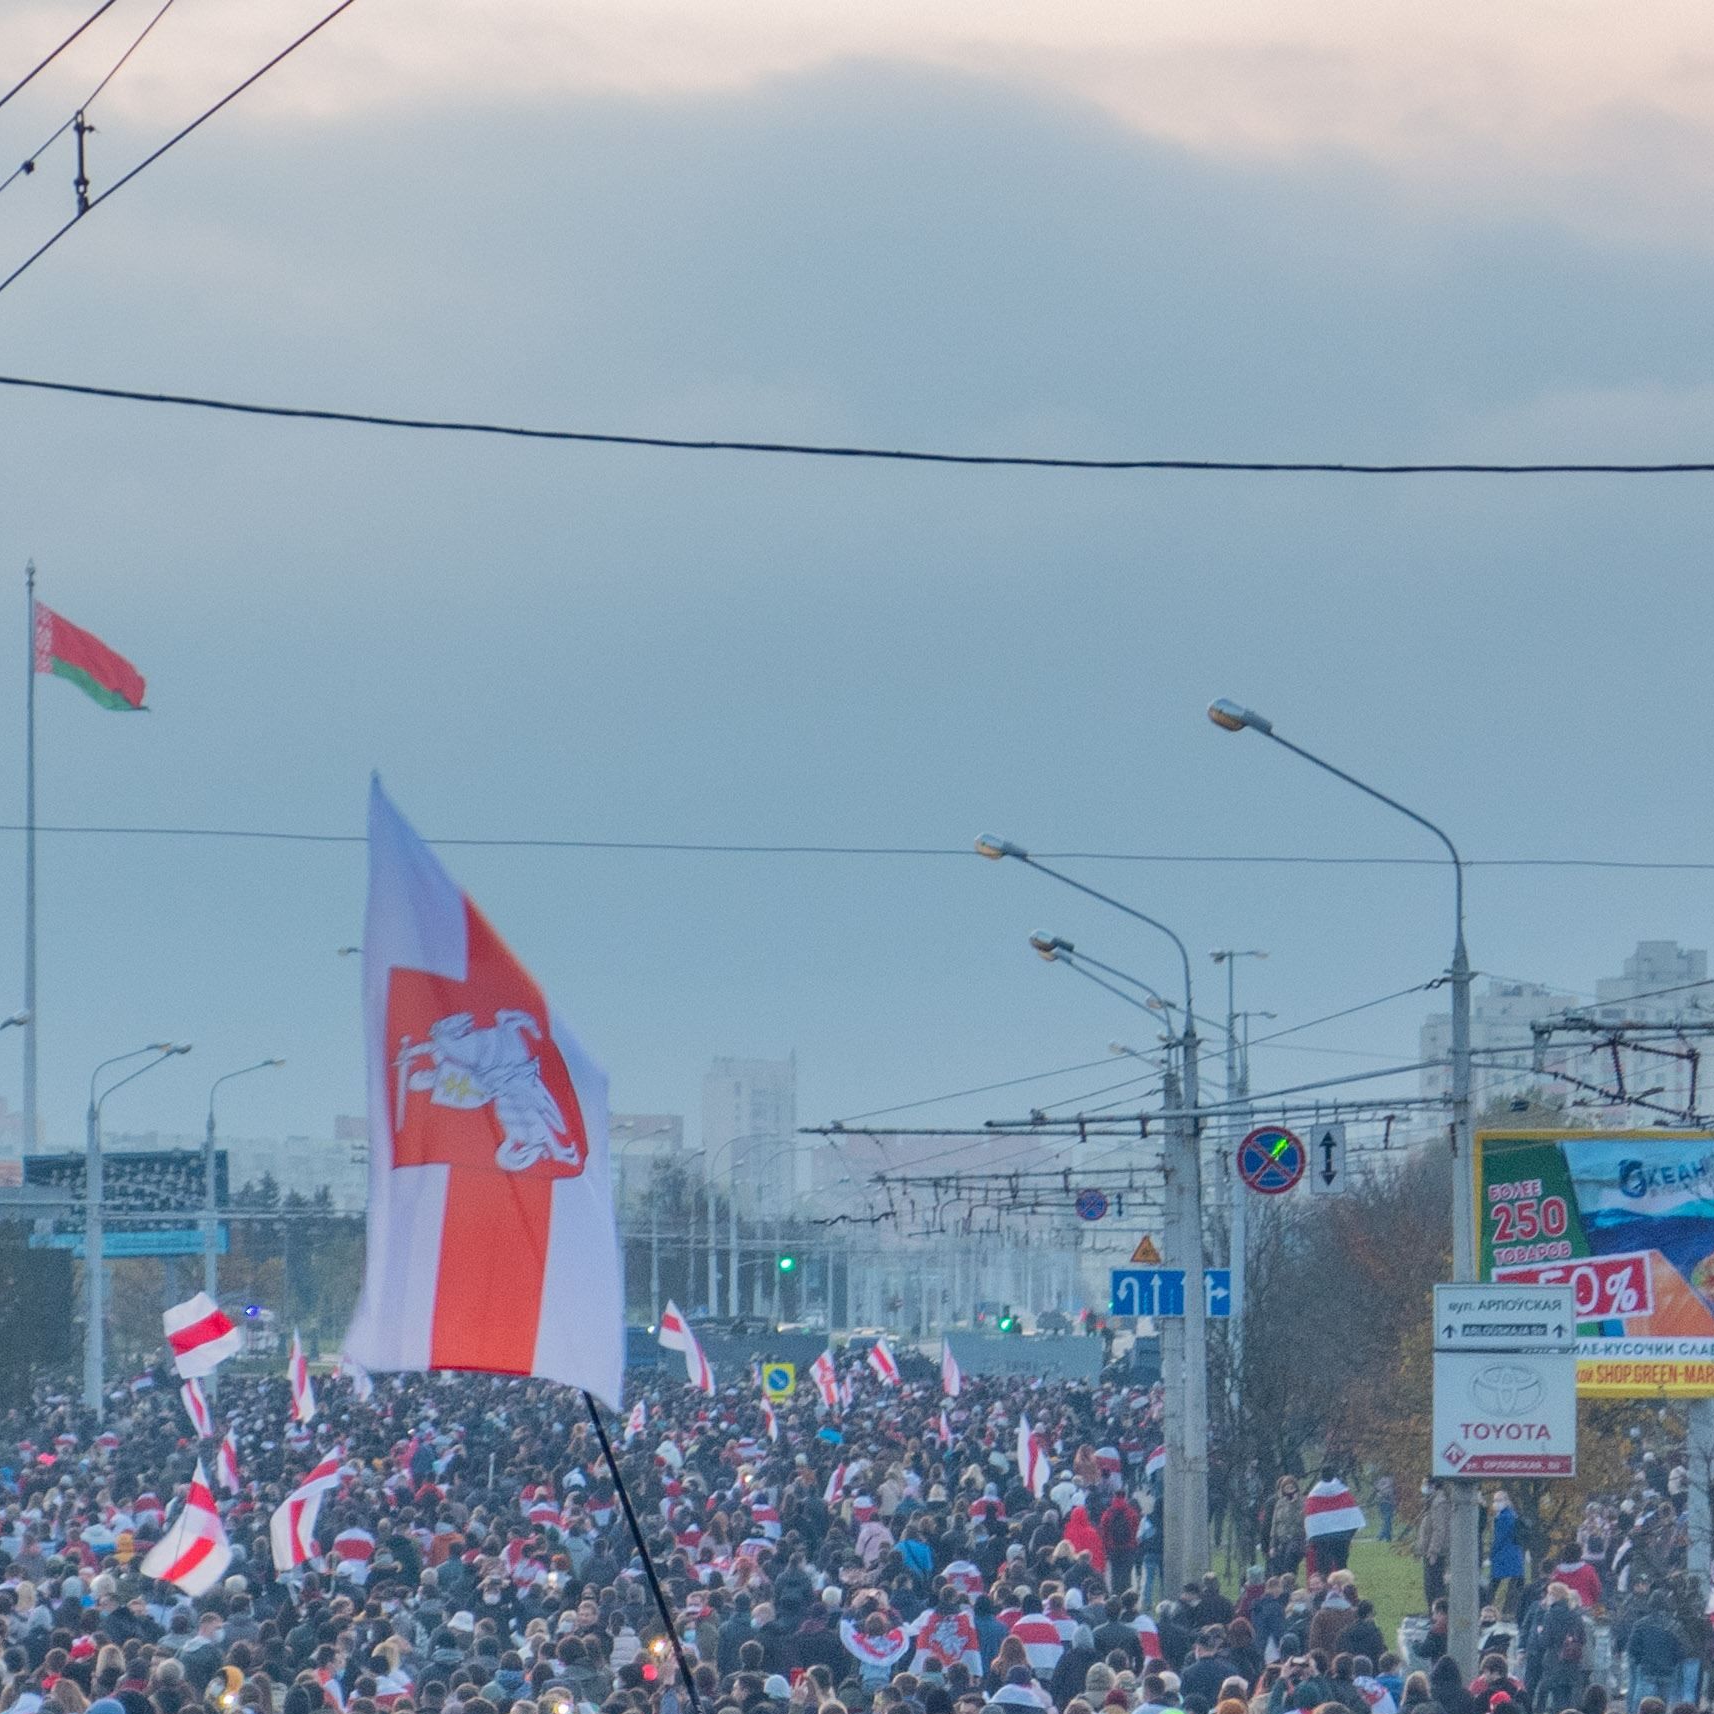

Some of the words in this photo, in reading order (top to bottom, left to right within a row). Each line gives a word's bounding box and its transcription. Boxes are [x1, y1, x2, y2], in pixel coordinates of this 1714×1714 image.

[1488, 1179, 1543, 1201] БОЛЕЕ
[1490, 1196, 1567, 1244] 250
[1493, 1241, 1572, 1265] ТОВАРОВ
[1460, 1423, 1552, 1440] TOYOTA
